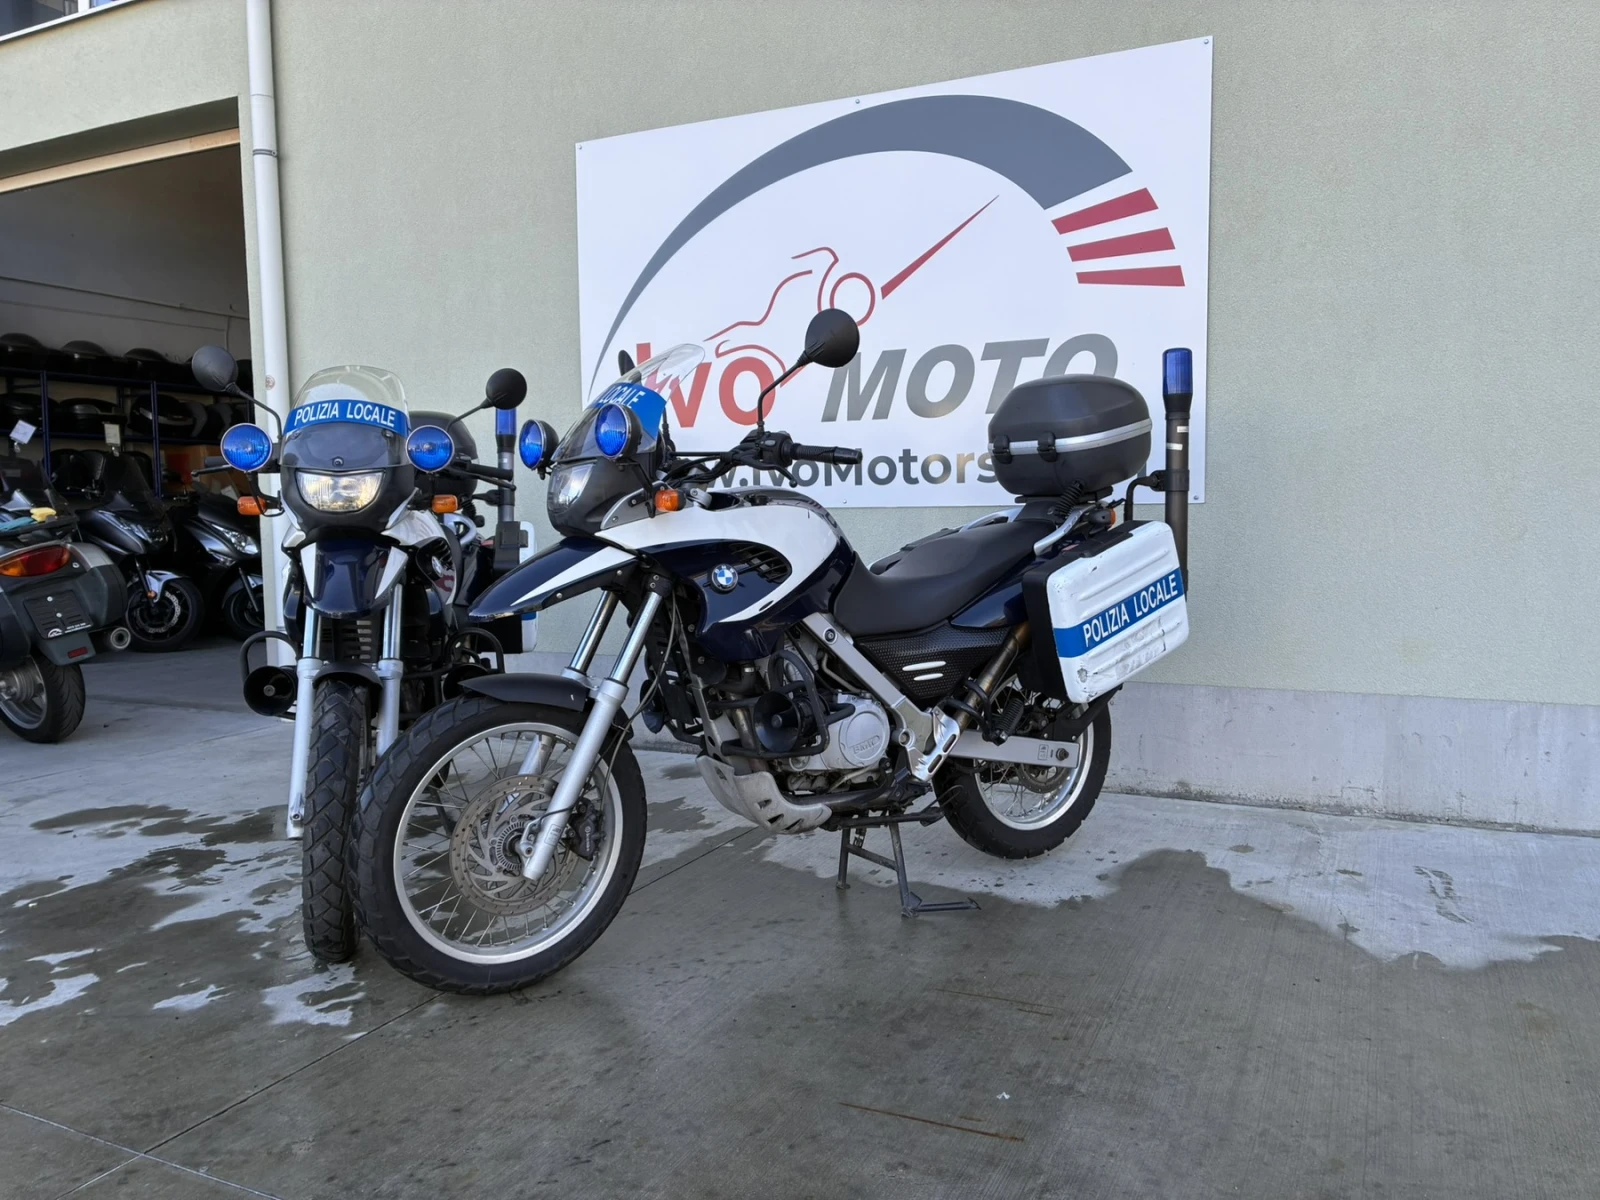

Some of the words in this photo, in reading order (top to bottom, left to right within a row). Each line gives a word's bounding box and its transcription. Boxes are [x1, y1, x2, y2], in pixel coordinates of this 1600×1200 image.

[294, 402, 339, 427] POLIZIA
[346, 402, 396, 427] LOCALE
[821, 333, 1118, 422] MOTO
[1083, 602, 1130, 647] POLIZIA
[1133, 573, 1178, 617] LOCALE
